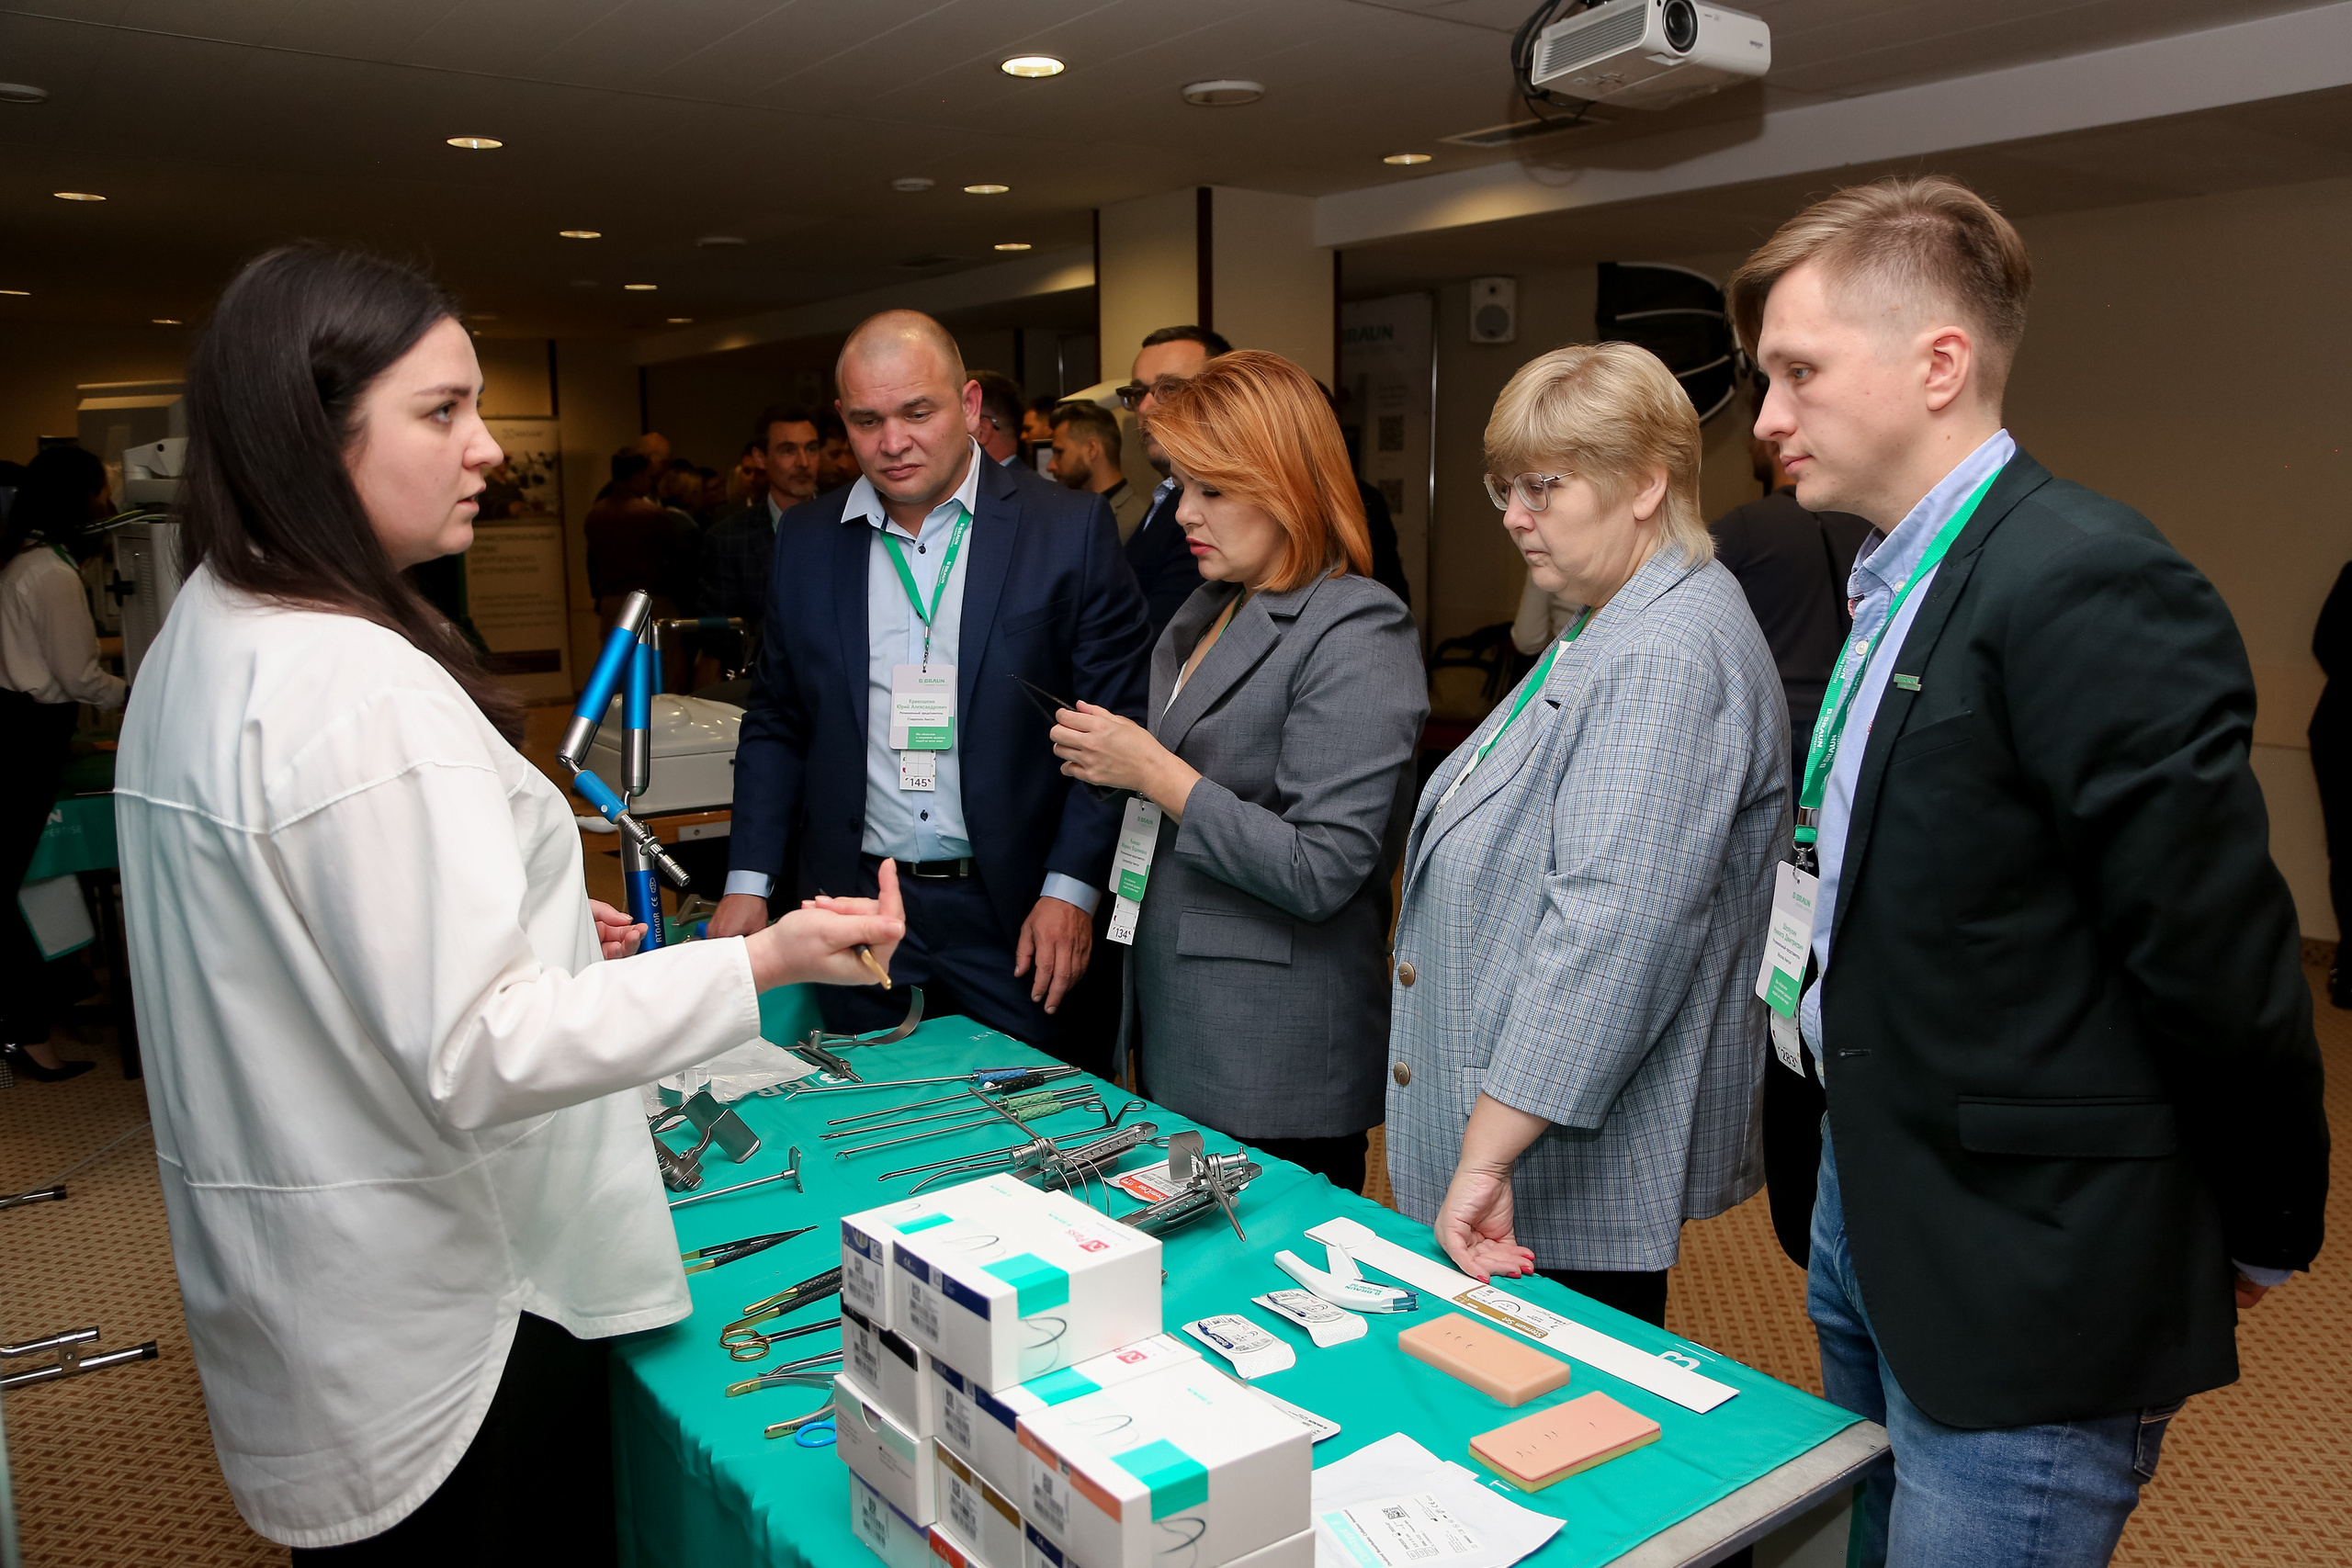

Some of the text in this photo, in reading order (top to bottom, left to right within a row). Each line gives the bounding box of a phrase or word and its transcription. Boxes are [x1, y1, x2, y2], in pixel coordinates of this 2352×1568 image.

[954, 527, 965, 546] BRAUN
[1816, 716, 1830, 748] BRAUN
[910, 778, 928, 787] 145
[1114, 928, 1128, 940] 134
[1344, 1285, 1372, 1293] BRAUN
[1501, 1316, 1515, 1325] Set
[1514, 1321, 1544, 1338] Sternum
